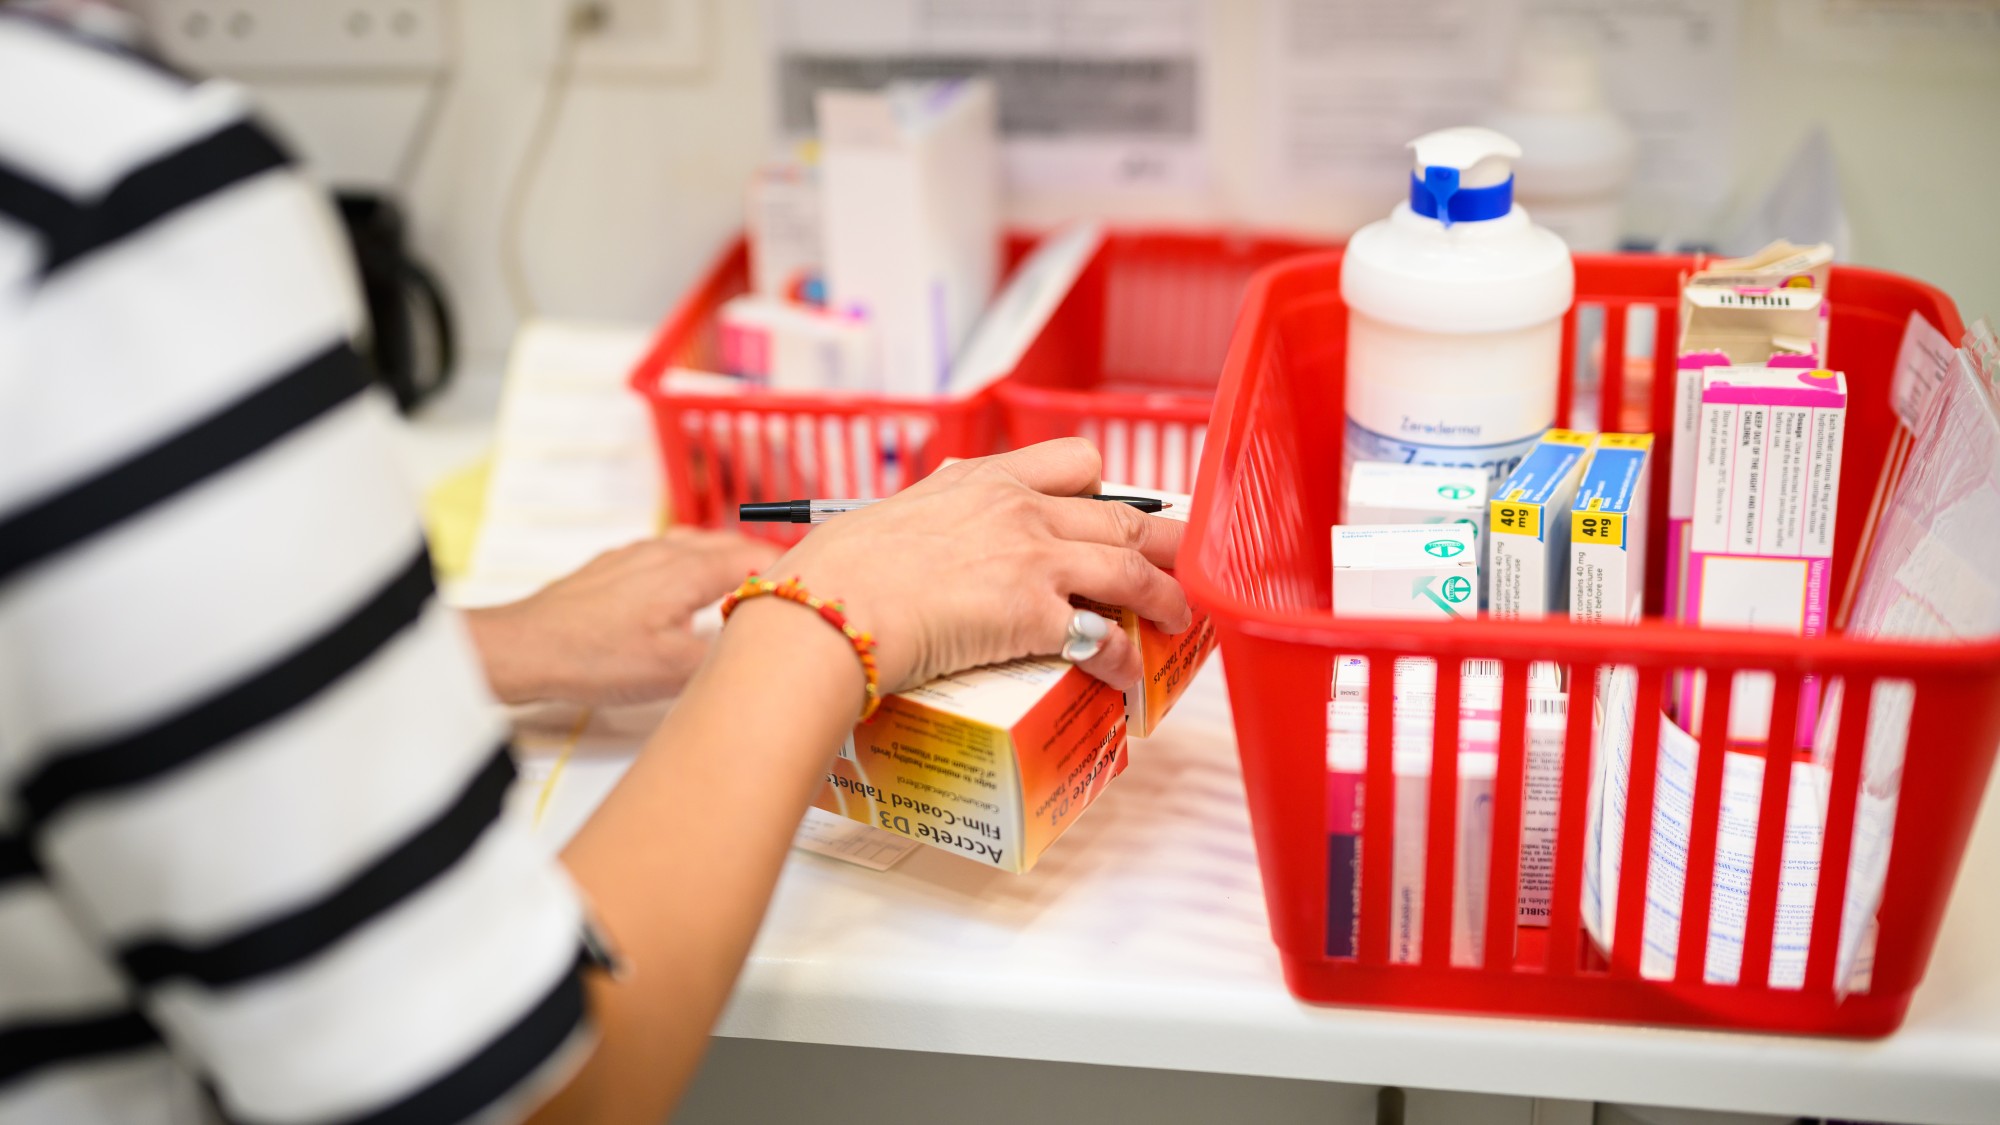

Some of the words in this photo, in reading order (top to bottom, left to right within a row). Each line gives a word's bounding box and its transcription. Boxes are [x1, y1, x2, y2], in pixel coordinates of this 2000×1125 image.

[1401, 415, 1482, 436] Zeroderma
[1501, 508, 1514, 527] 40
[1518, 509, 1529, 528] mg
[1582, 518, 1596, 536] 40
[1600, 518, 1611, 538] mg
[1496, 541, 1504, 554] mg
[1496, 556, 1502, 566] 40
[1578, 552, 1585, 564] mg
[1577, 566, 1584, 576] 40
[1595, 583, 1603, 608] before
[1153, 651, 1178, 685] Tablets
[1067, 725, 1117, 787] Film-Coated
[891, 793, 1000, 839] Film-Coated
[1051, 796, 1069, 826] D3
[878, 810, 911, 835] D3
